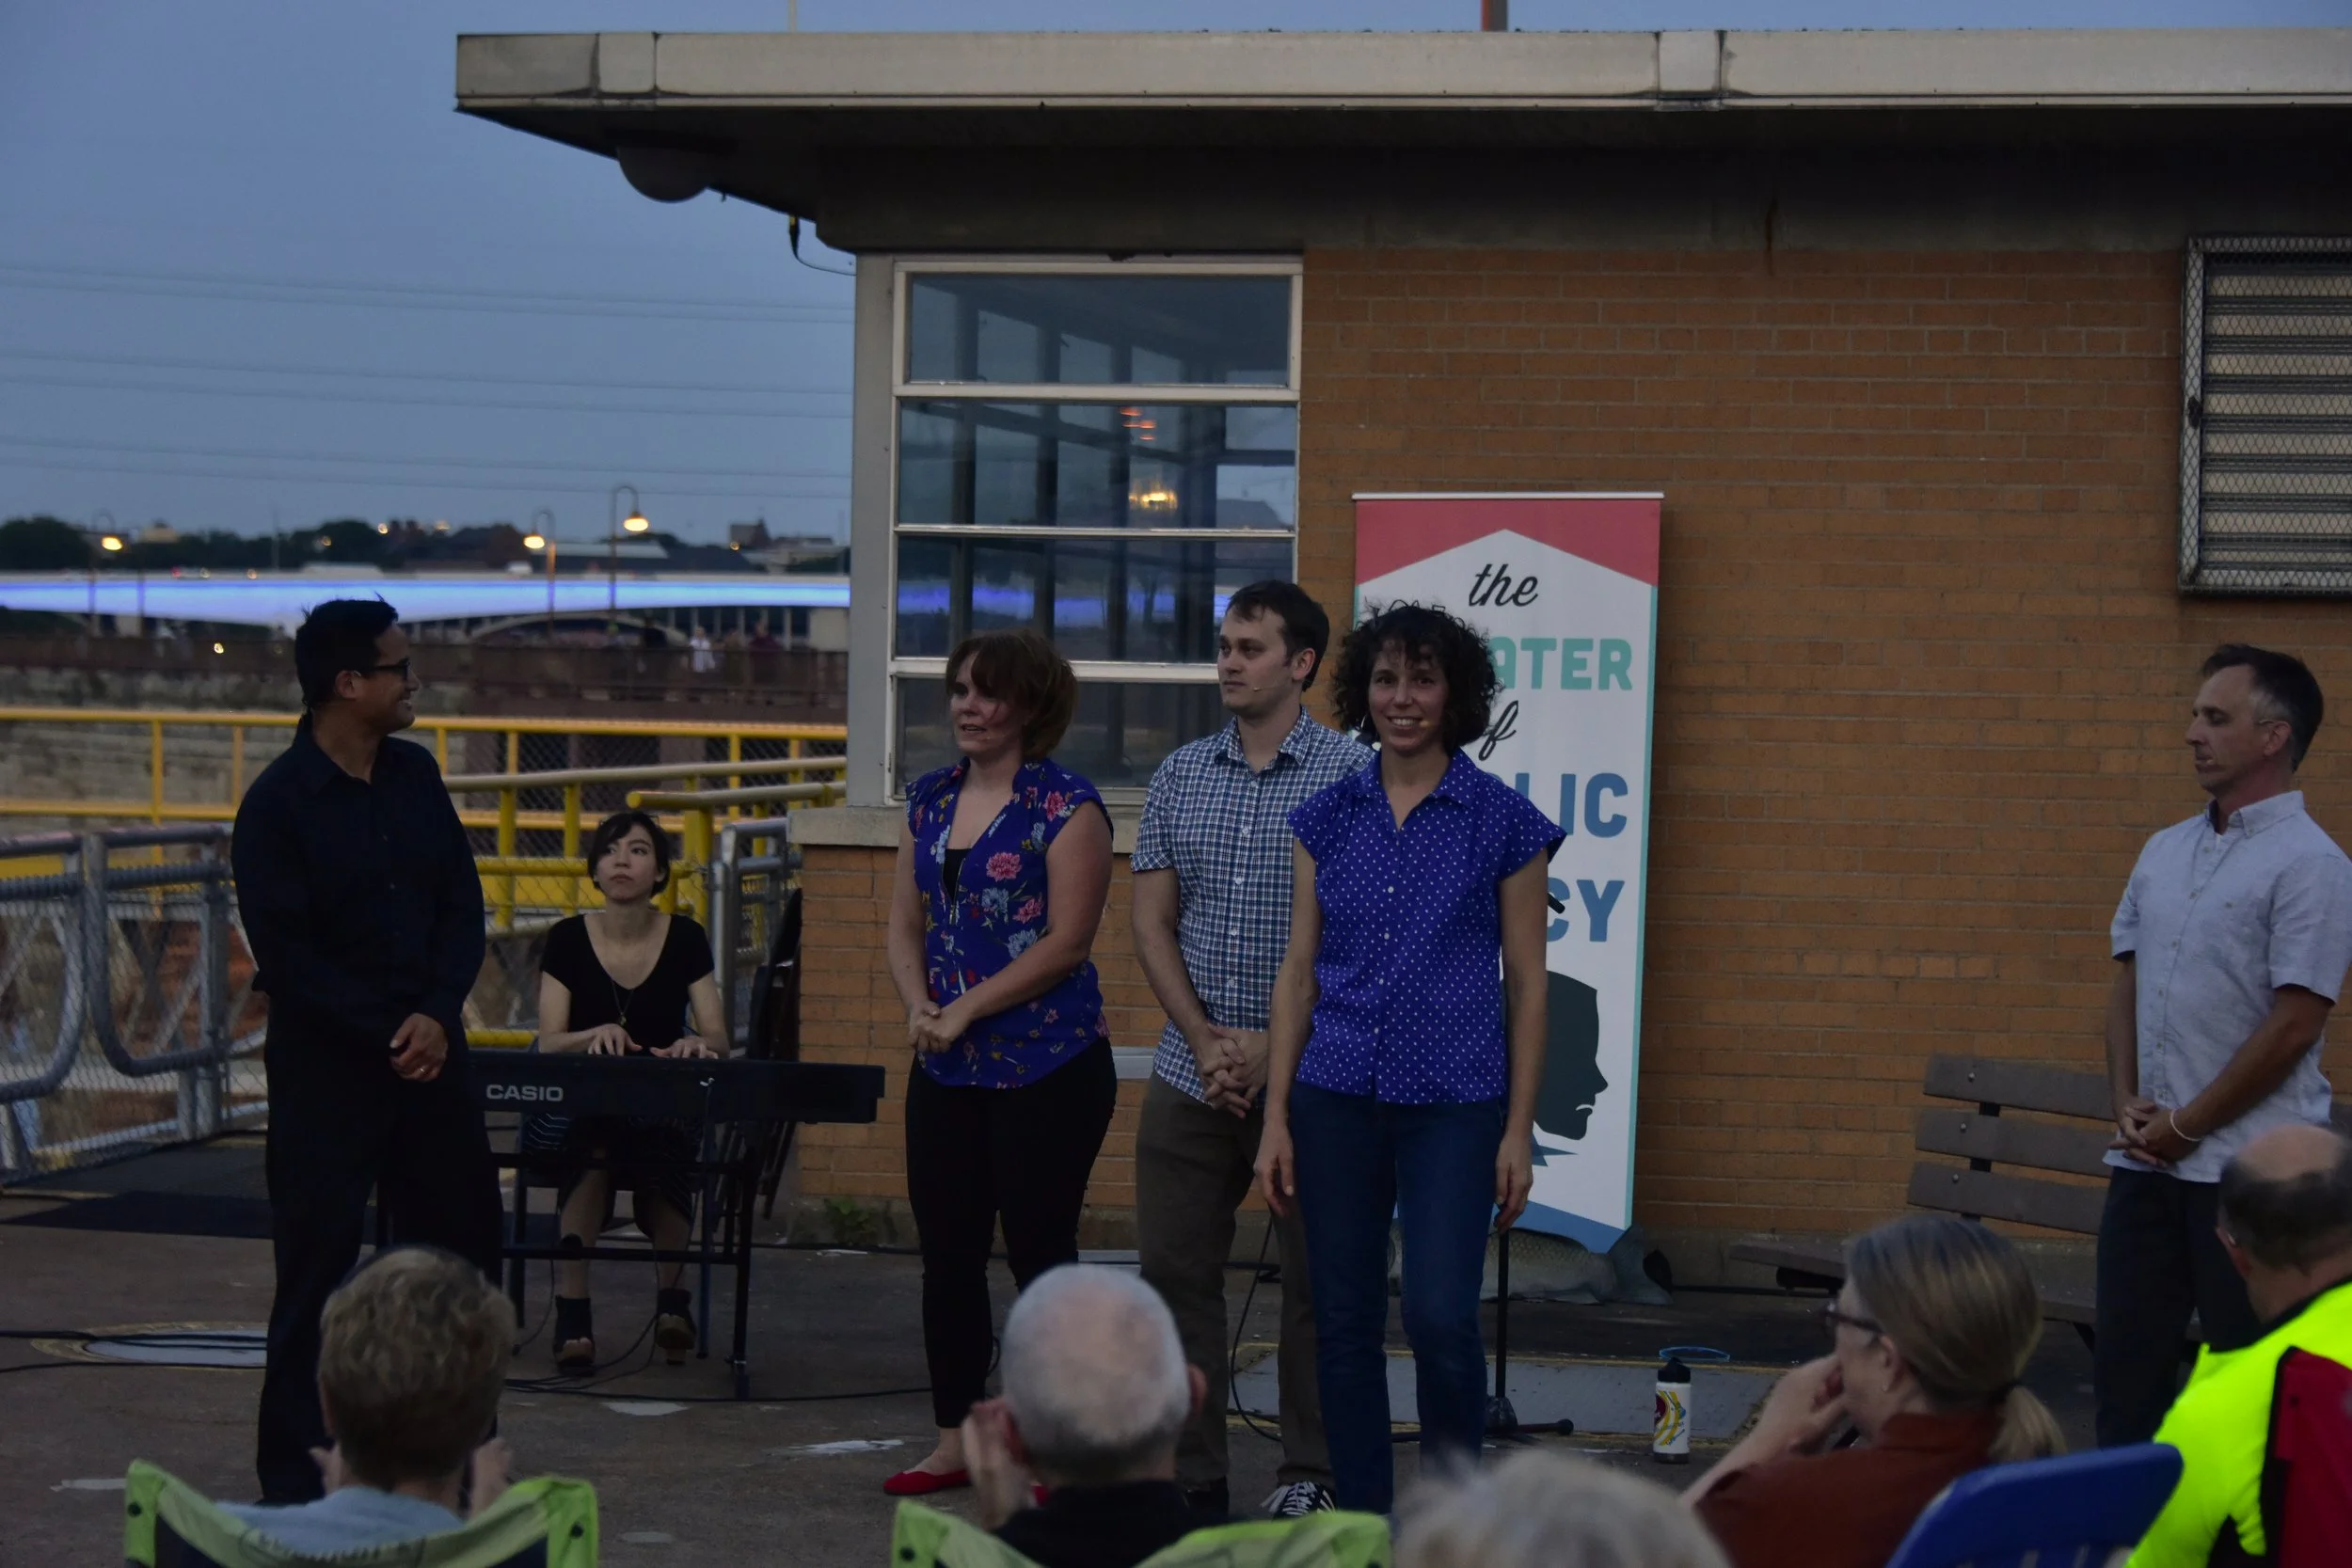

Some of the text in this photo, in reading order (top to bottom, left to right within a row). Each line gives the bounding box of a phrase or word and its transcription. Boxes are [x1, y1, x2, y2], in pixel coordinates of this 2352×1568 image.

[1469, 563, 1538, 607] the
[1486, 636, 1633, 690] ATER
[1478, 700, 1518, 761] f
[485, 1084, 564, 1102] CASIO
